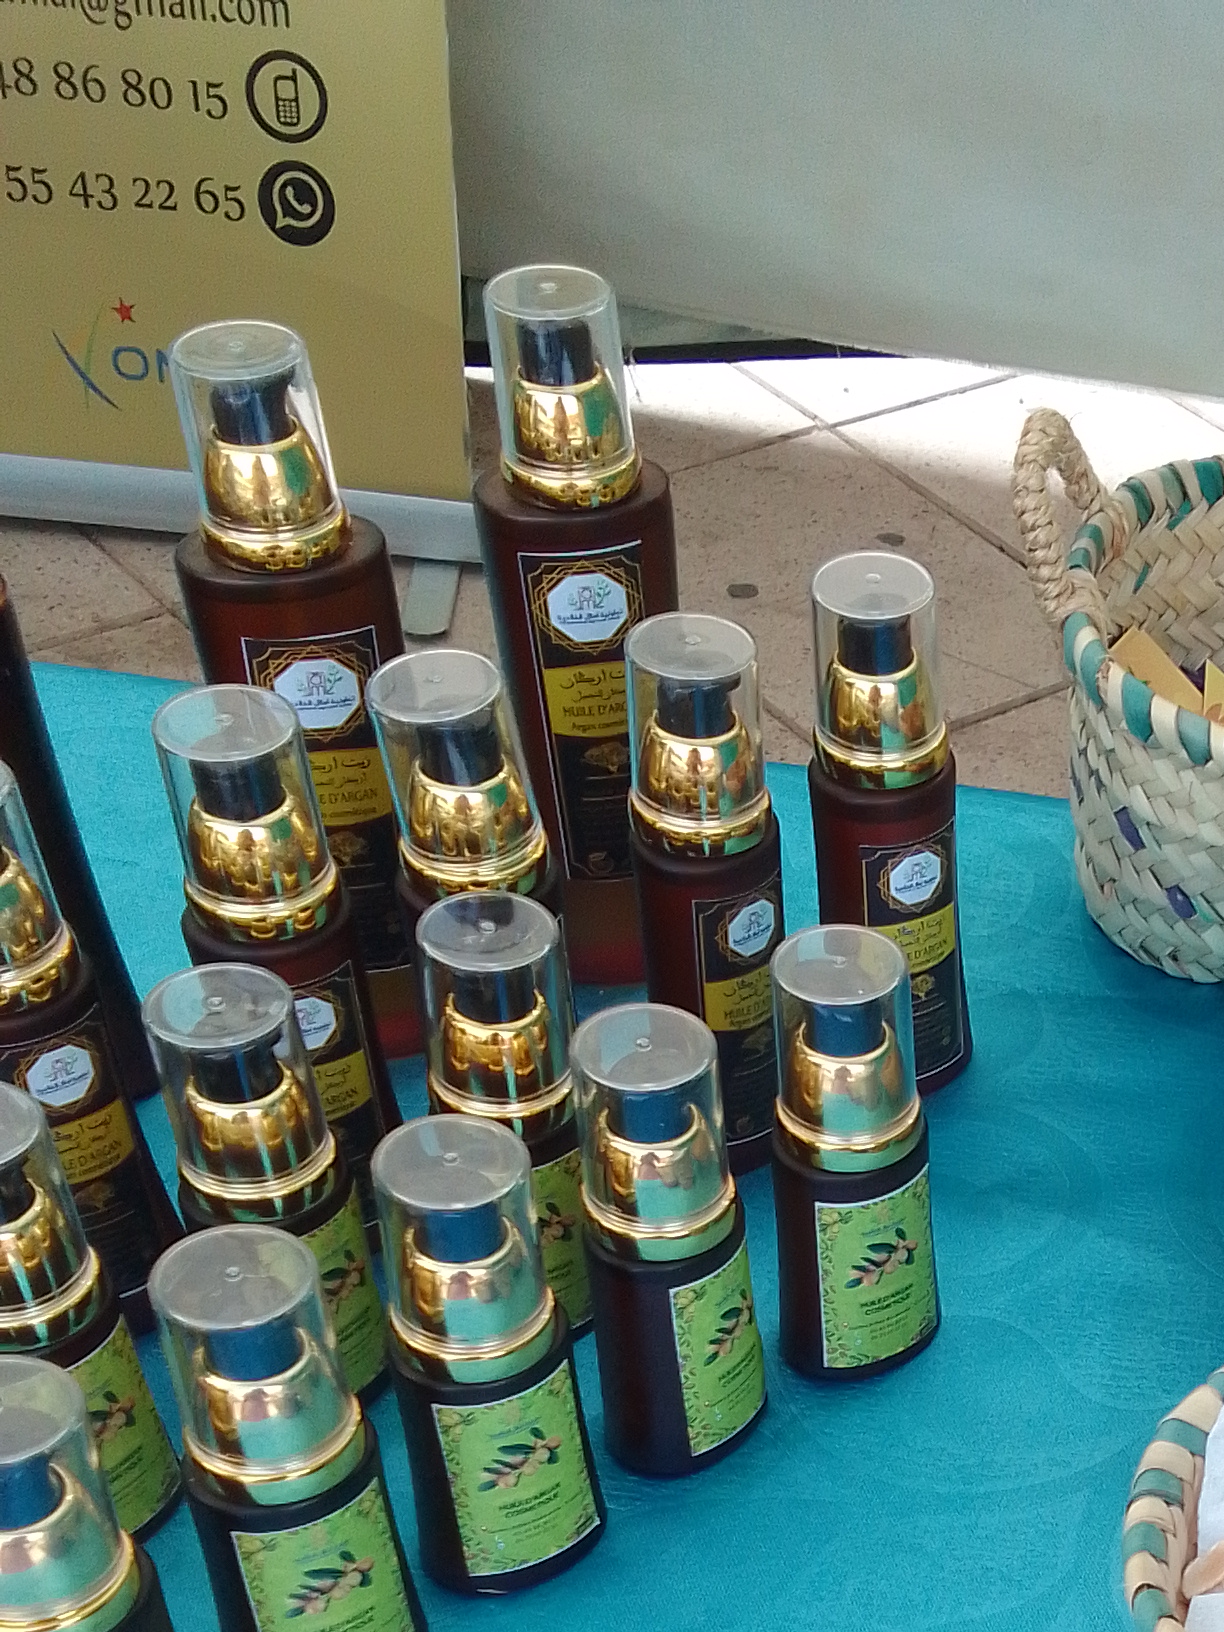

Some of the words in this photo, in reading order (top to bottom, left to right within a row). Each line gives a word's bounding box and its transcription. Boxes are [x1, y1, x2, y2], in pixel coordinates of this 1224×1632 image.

[52, 61, 106, 103] 86
[120, 68, 173, 110] 80
[187, 79, 228, 120] 15
[5, 164, 53, 205] 55
[69, 171, 118, 211] 43
[132, 176, 178, 211] 22
[194, 176, 246, 222] 65
